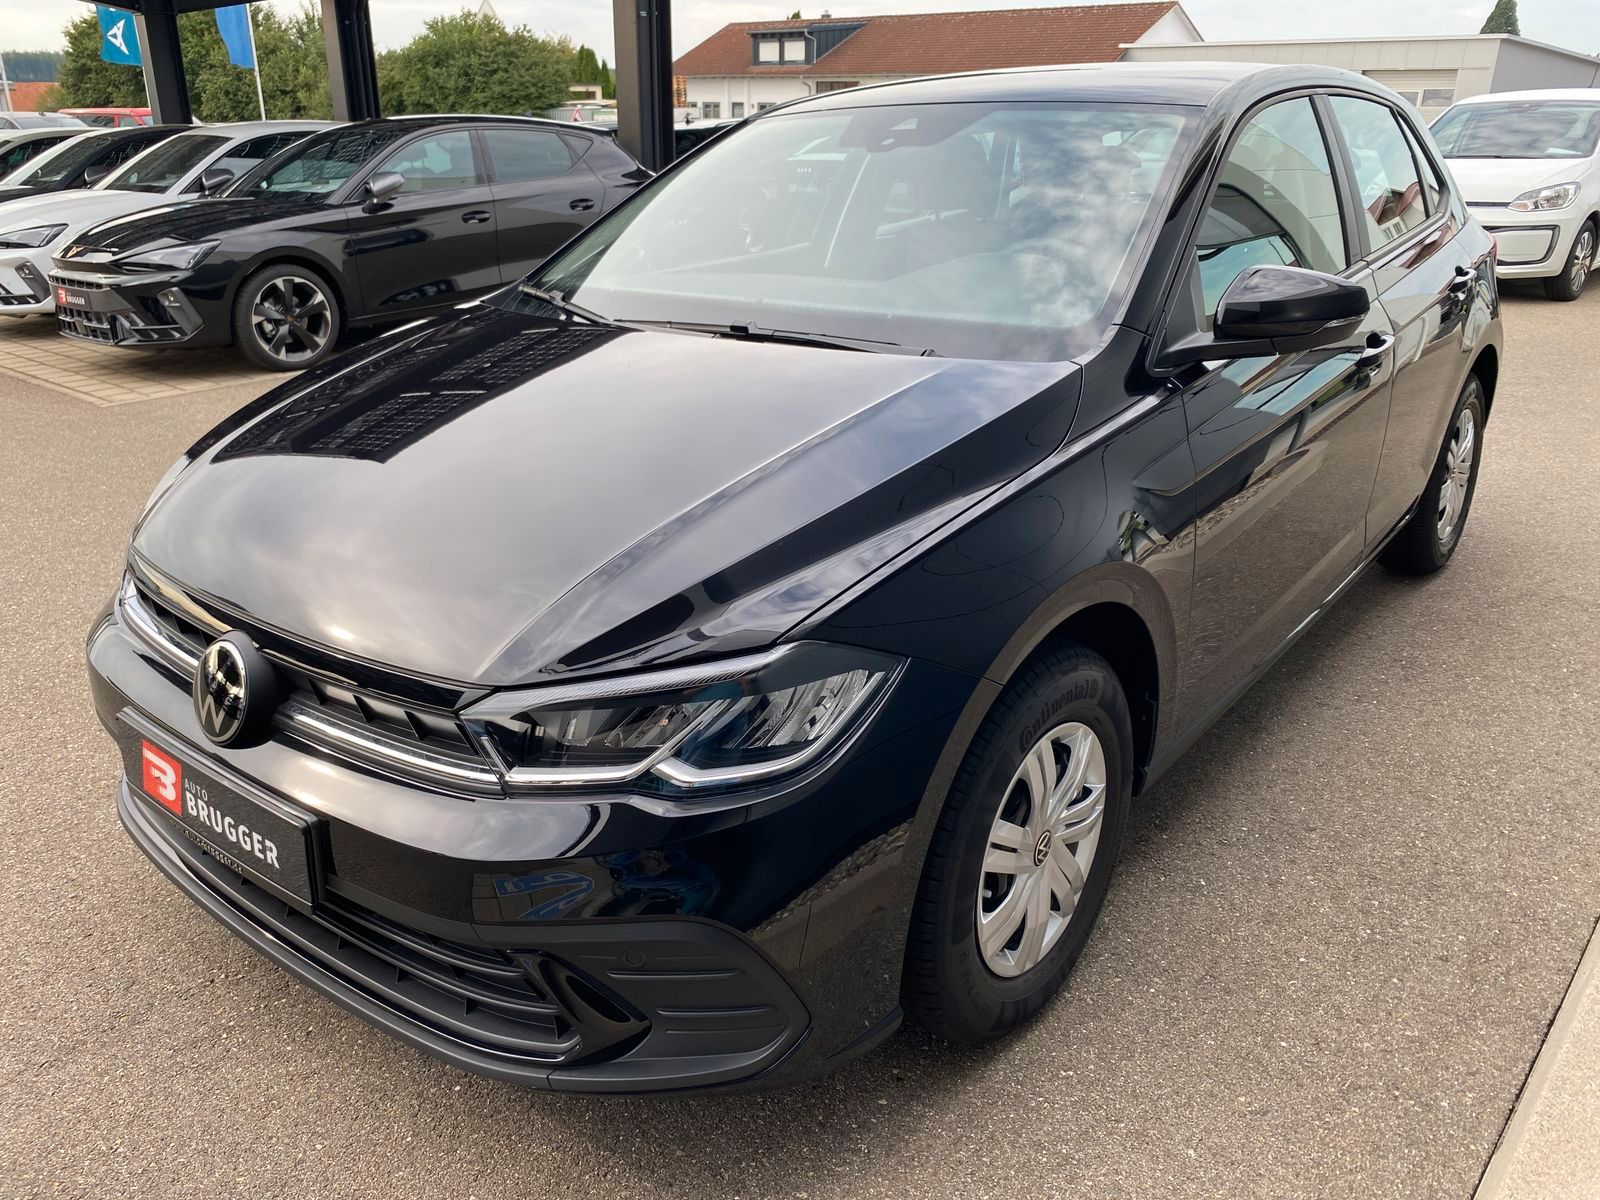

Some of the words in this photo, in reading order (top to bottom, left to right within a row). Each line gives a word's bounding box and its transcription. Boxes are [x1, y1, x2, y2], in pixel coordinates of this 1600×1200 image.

[1019, 679, 1090, 752] Continental
[184, 778, 208, 801] AUTO
[185, 790, 280, 870] BRUGGER
